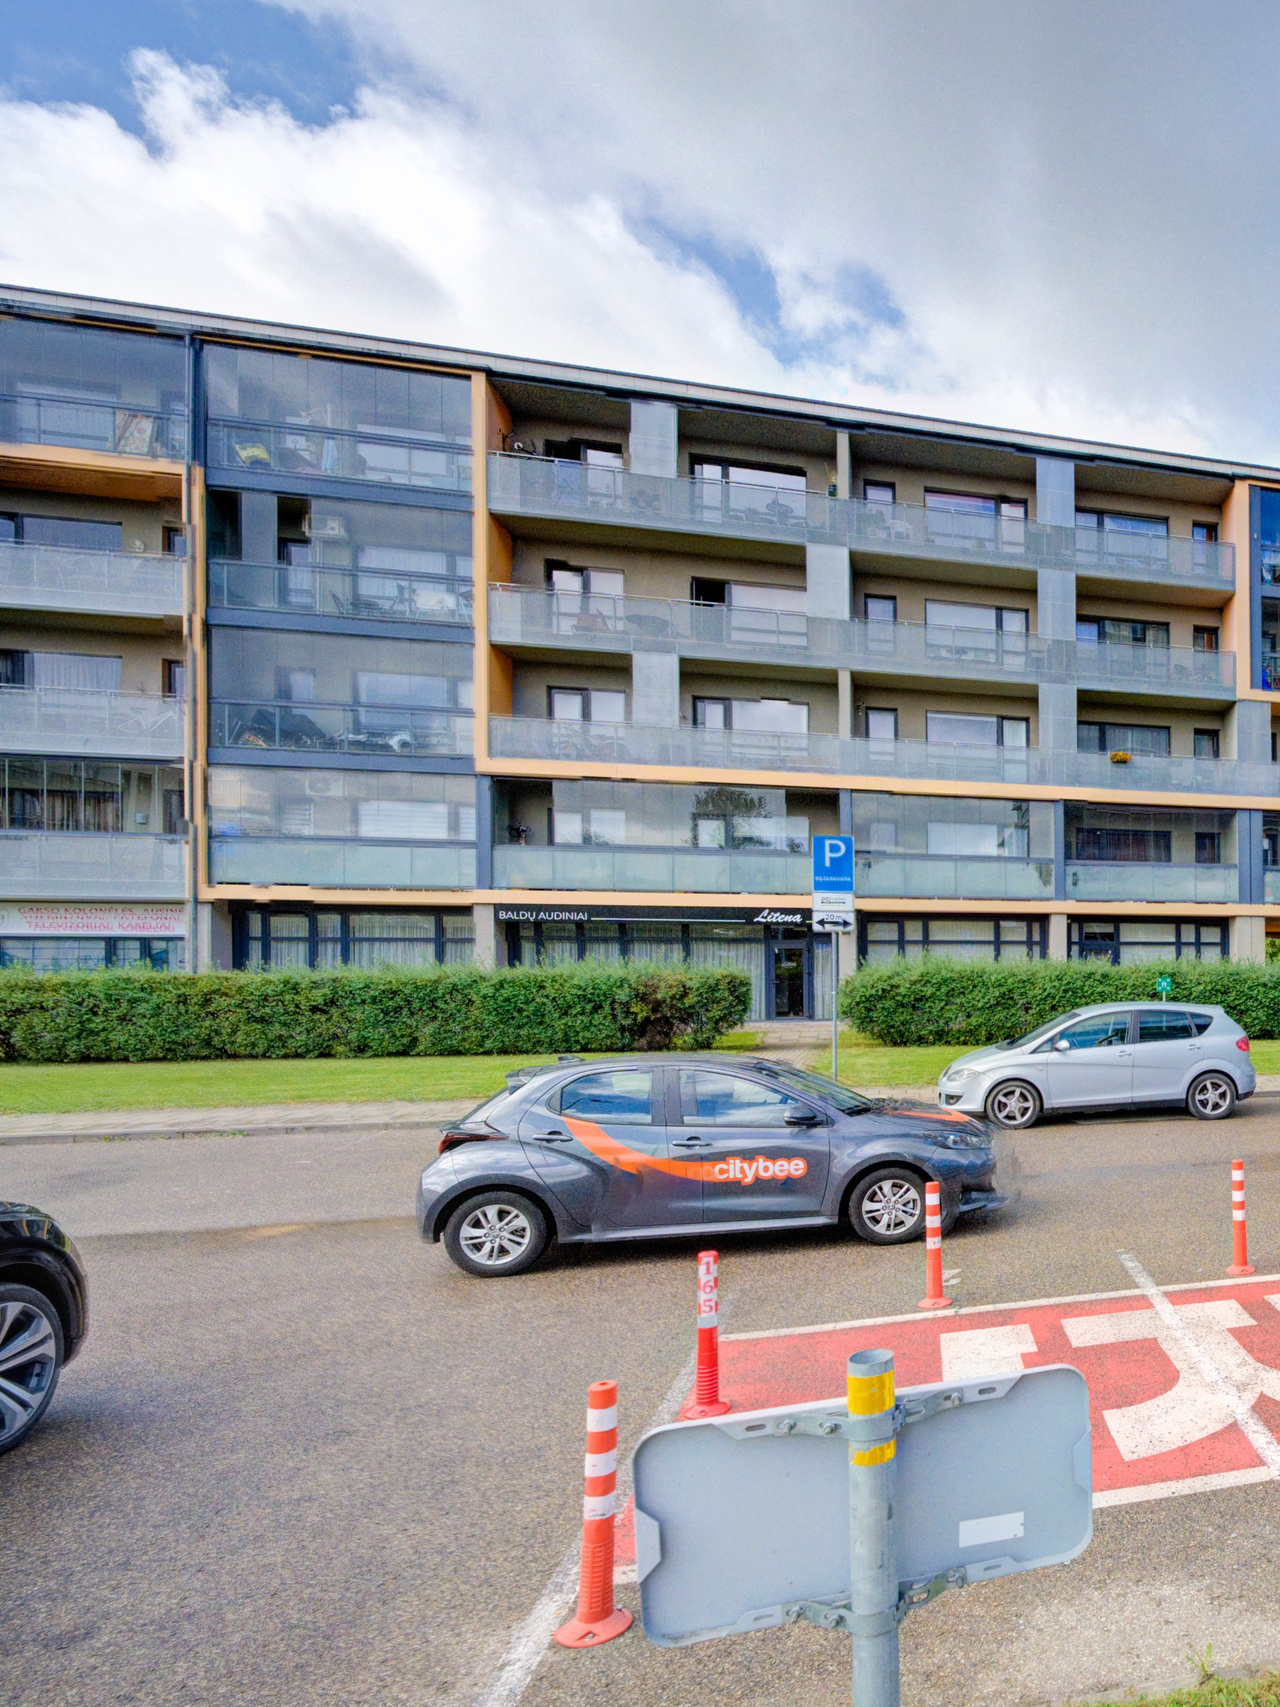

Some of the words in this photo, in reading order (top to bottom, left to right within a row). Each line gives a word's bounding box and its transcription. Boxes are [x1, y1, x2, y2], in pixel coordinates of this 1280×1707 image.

[825, 839, 846, 867] P
[18, 906, 61, 915] GARSO
[499, 911, 536, 921] BALDŲ
[538, 911, 588, 921] AUDINIAI
[754, 909, 803, 923] Litena
[825, 913, 835, 921] 20
[713, 1157, 805, 1183] citybee
